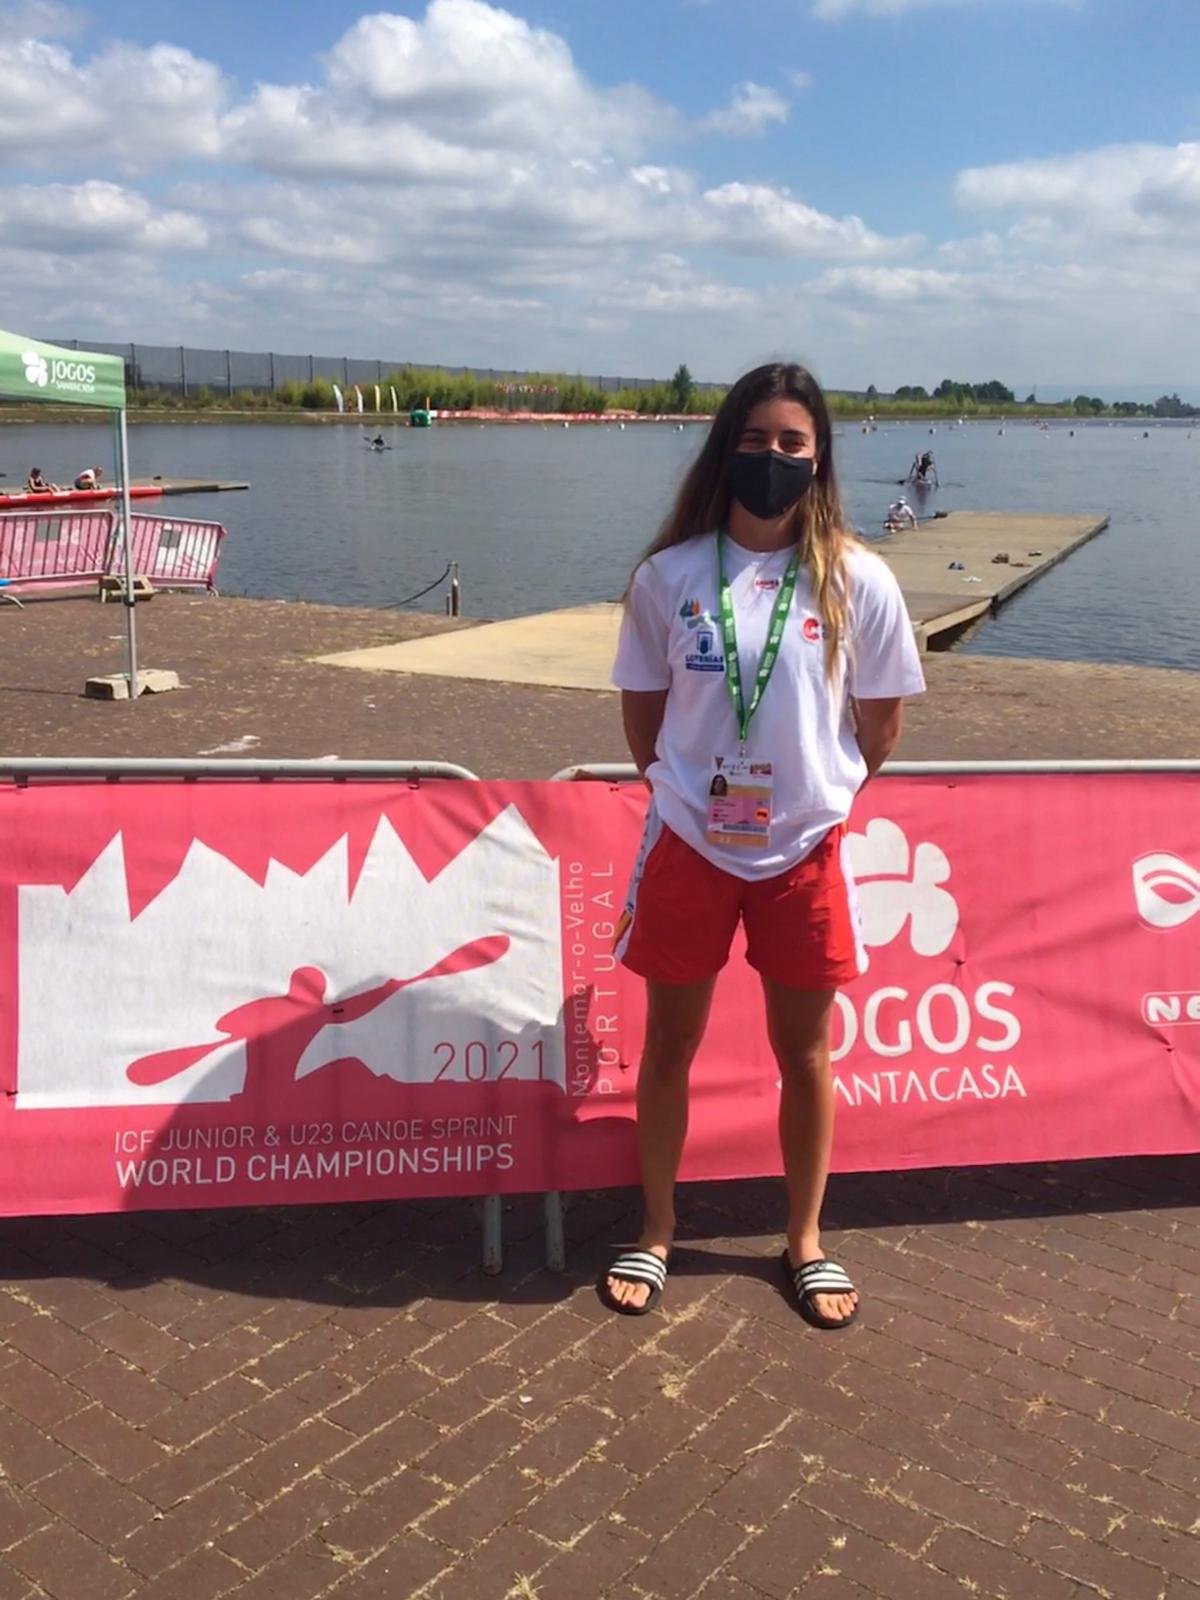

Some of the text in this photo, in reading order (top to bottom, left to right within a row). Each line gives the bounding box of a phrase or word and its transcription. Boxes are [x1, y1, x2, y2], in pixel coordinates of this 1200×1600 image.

[50, 359, 96, 384] JOGOS
[591, 861, 621, 1095] PORTUGAL
[829, 981, 1021, 1062] OGOS
[433, 1041, 545, 1082] 2021
[776, 1064, 1027, 1106] ANTACASA
[114, 1114, 518, 1154] ICF JUNIOR & U23 CANOE SPRINT
[115, 1143, 516, 1188] WORLD CHAMPIONSHIPS
